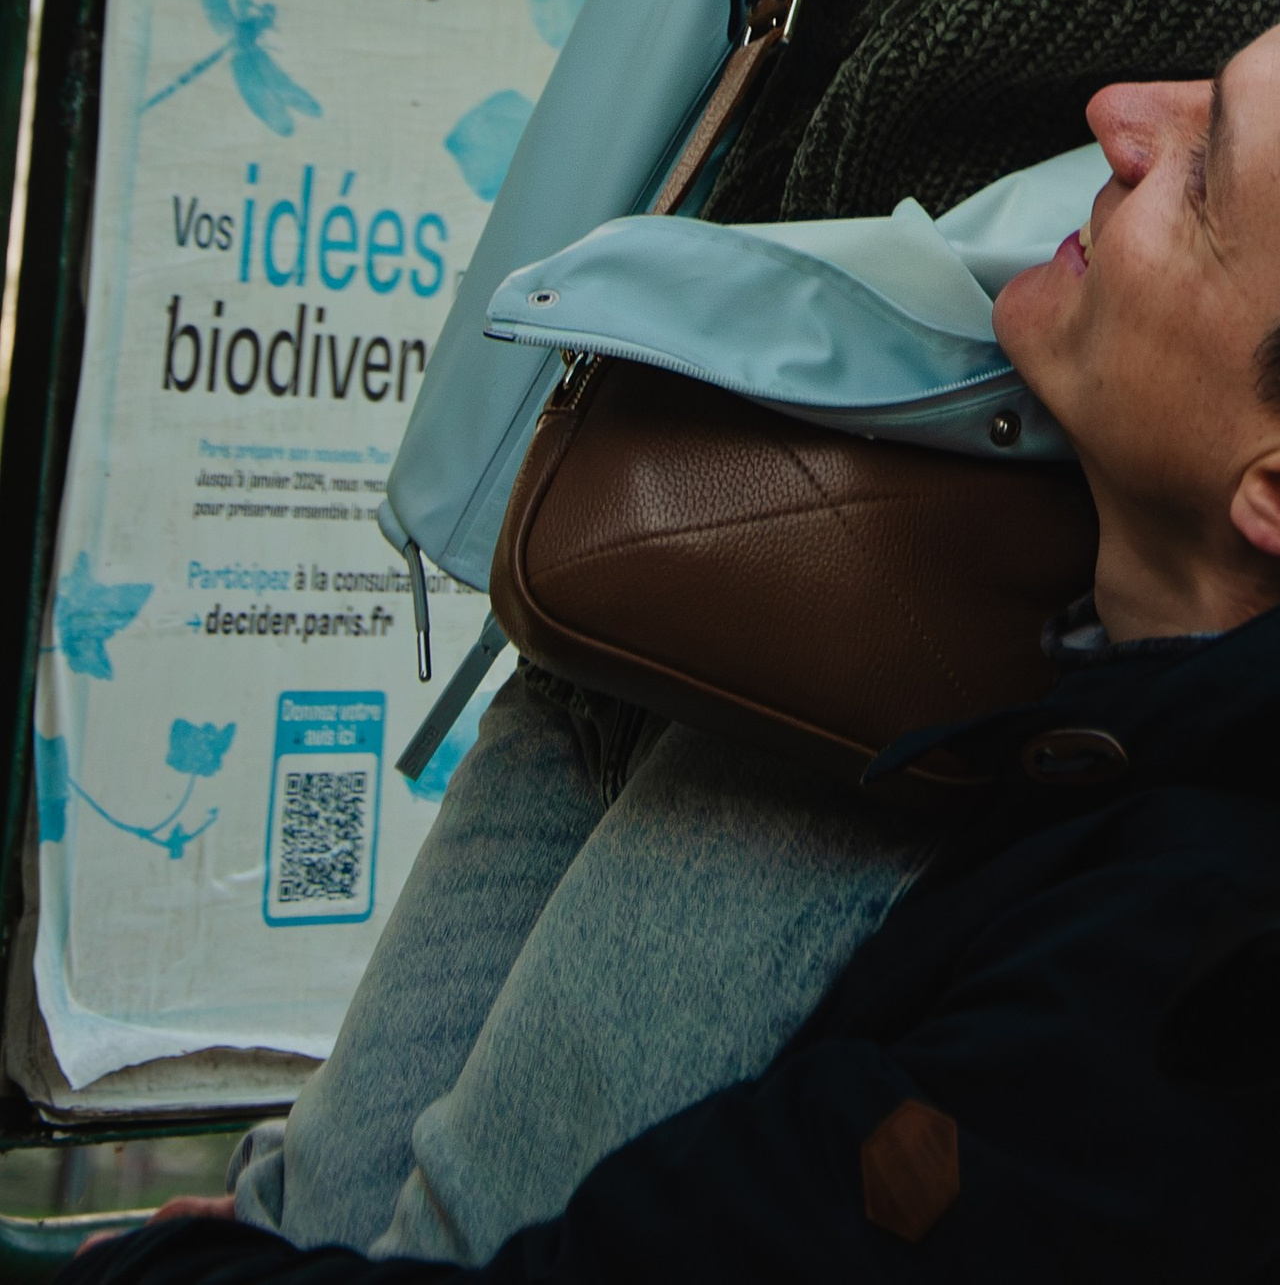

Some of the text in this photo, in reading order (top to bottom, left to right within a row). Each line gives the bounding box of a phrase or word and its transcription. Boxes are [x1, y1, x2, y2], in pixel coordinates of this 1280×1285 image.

[172, 161, 448, 298] Vos idées
[163, 294, 427, 403] biodiver
[188, 560, 290, 596] Participez
[295, 564, 306, 592] à
[310, 564, 328, 593] la
[332, 565, 450, 593] consultaon
[205, 603, 394, 643] decider.paris.fr
